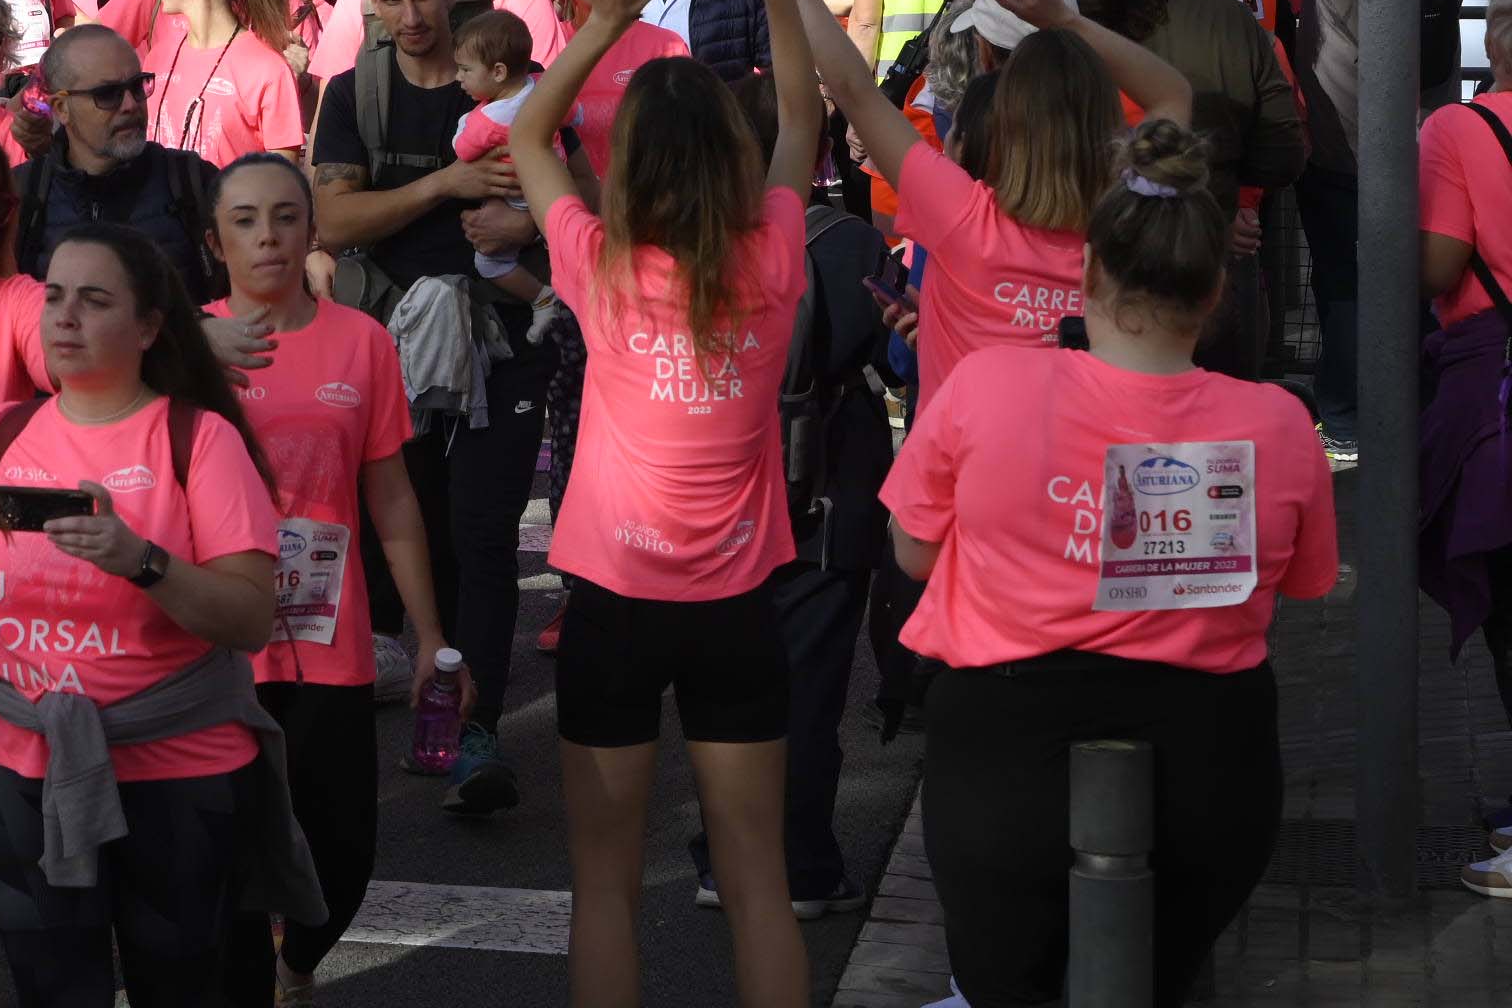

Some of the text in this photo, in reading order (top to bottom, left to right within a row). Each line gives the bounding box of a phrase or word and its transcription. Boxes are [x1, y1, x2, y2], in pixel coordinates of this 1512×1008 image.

[629, 330, 761, 356] CARERA
[656, 357, 692, 380] DE
[650, 379, 745, 403] MUJER
[687, 406, 712, 415] 2023
[1207, 464, 1241, 474] SUMA
[1137, 473, 1194, 487] ASTURIANA
[1047, 475, 1101, 507] CA
[1139, 509, 1193, 533] 016
[1143, 540, 1186, 555] 27213
[1146, 563, 1158, 571] DE
[1160, 562, 1173, 571] LA
[1174, 561, 1210, 570] MUJER
[1214, 560, 1237, 569] 2023
[1108, 583, 1243, 600] OYSHO Santander
